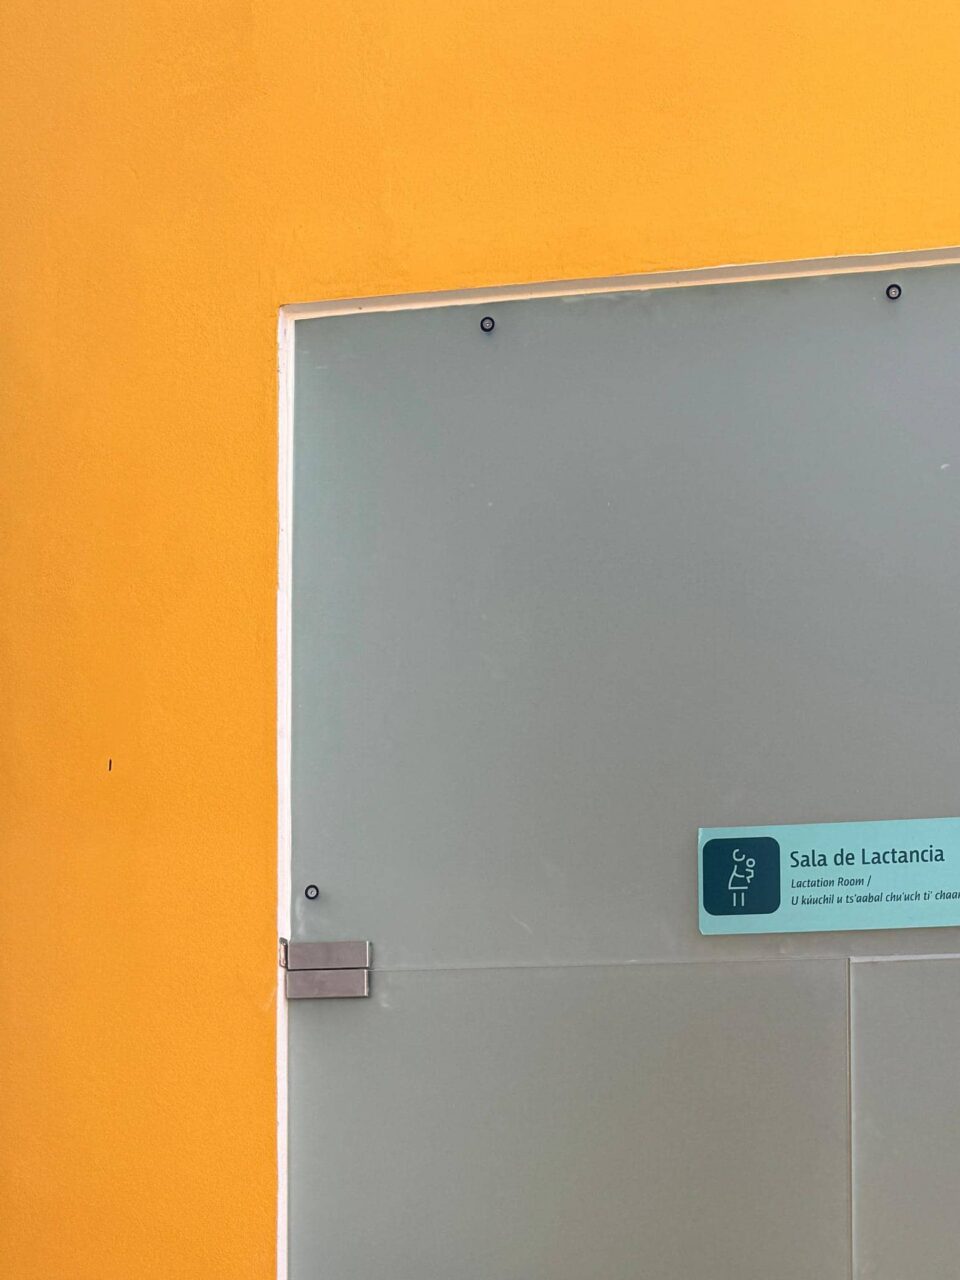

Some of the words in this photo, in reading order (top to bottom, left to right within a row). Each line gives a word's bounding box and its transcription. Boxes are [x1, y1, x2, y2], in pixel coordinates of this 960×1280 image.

[790, 849, 828, 868] Sala
[833, 848, 855, 866] de
[861, 845, 945, 865] Lactancia
[791, 877, 835, 889] Lactation
[837, 876, 865, 887] Room
[791, 896, 799, 906] U
[837, 896, 843, 904] u
[845, 892, 883, 904] ts'aabal
